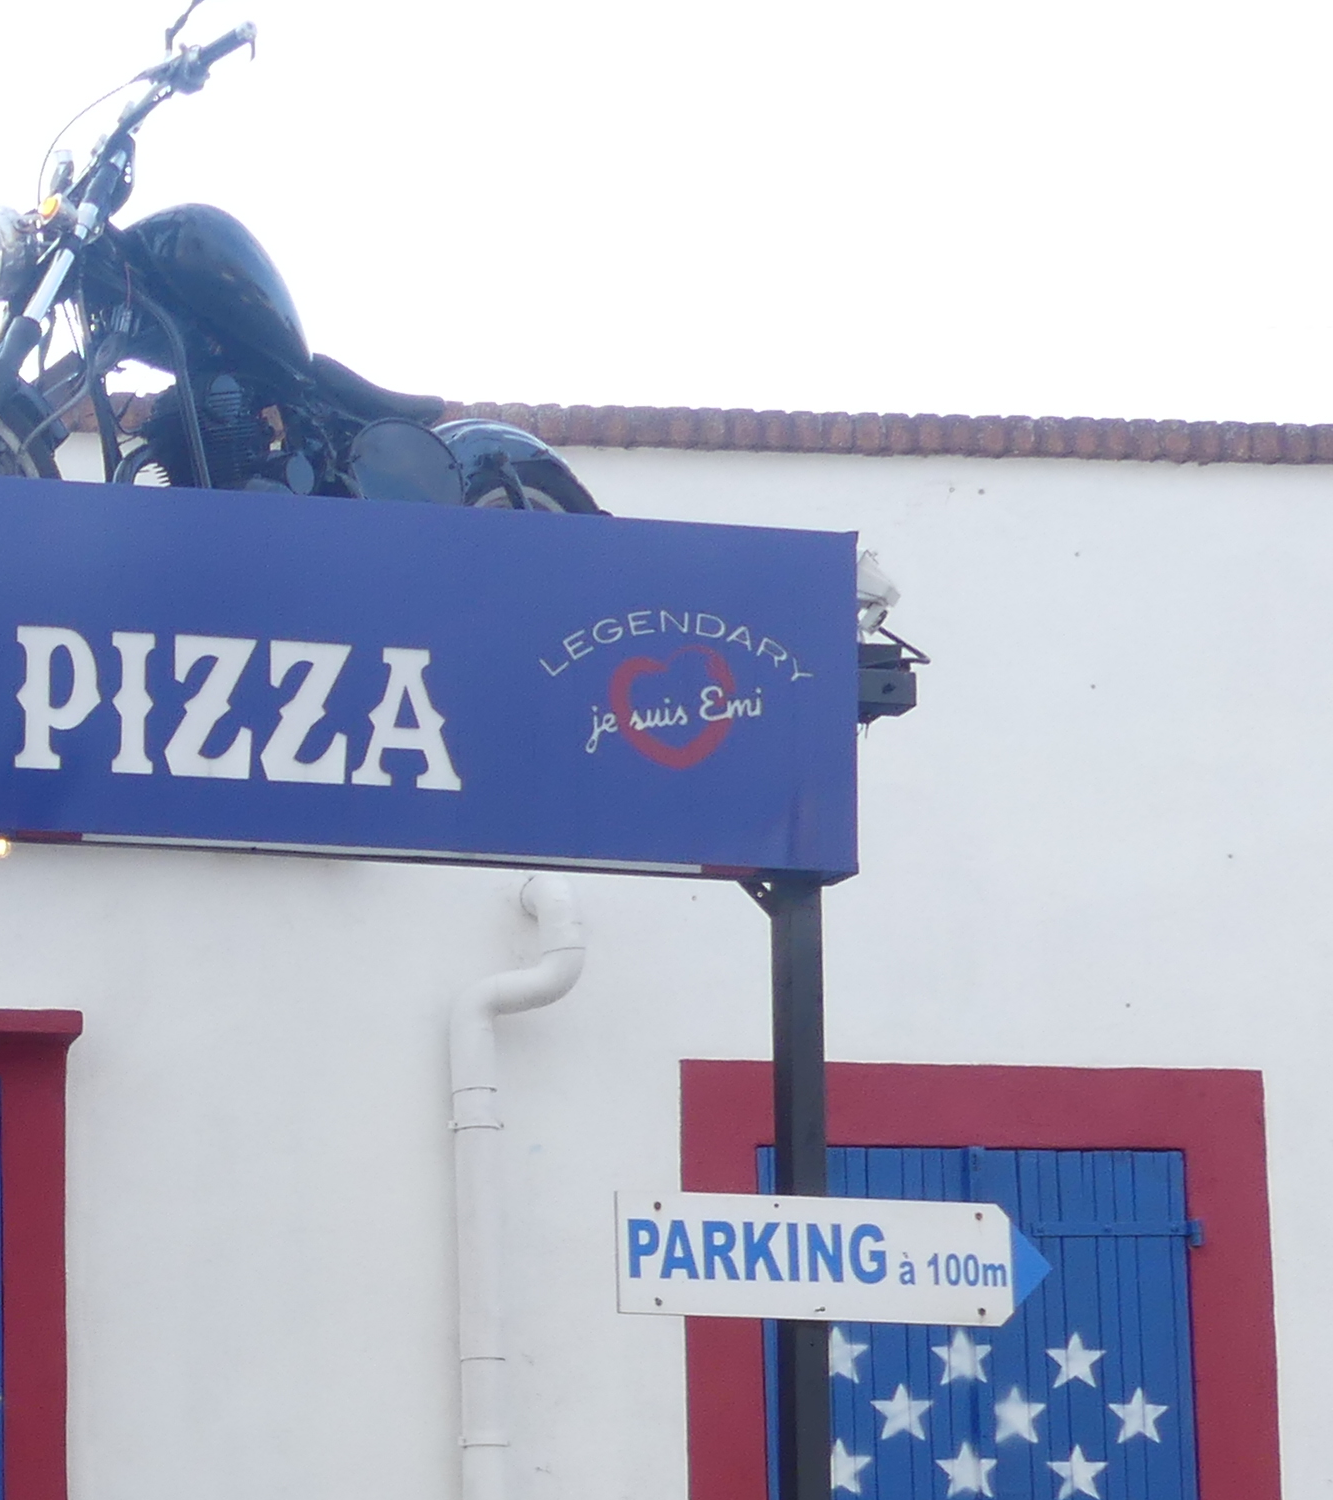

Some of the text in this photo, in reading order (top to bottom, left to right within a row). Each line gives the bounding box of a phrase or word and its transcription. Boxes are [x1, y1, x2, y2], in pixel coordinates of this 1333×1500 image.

[538, 609, 814, 682] LEGENDARY
[13, 625, 462, 792] PIZZA
[585, 685, 763, 754] je suis Emi
[627, 1217, 1008, 1288] PARKING à 100m
